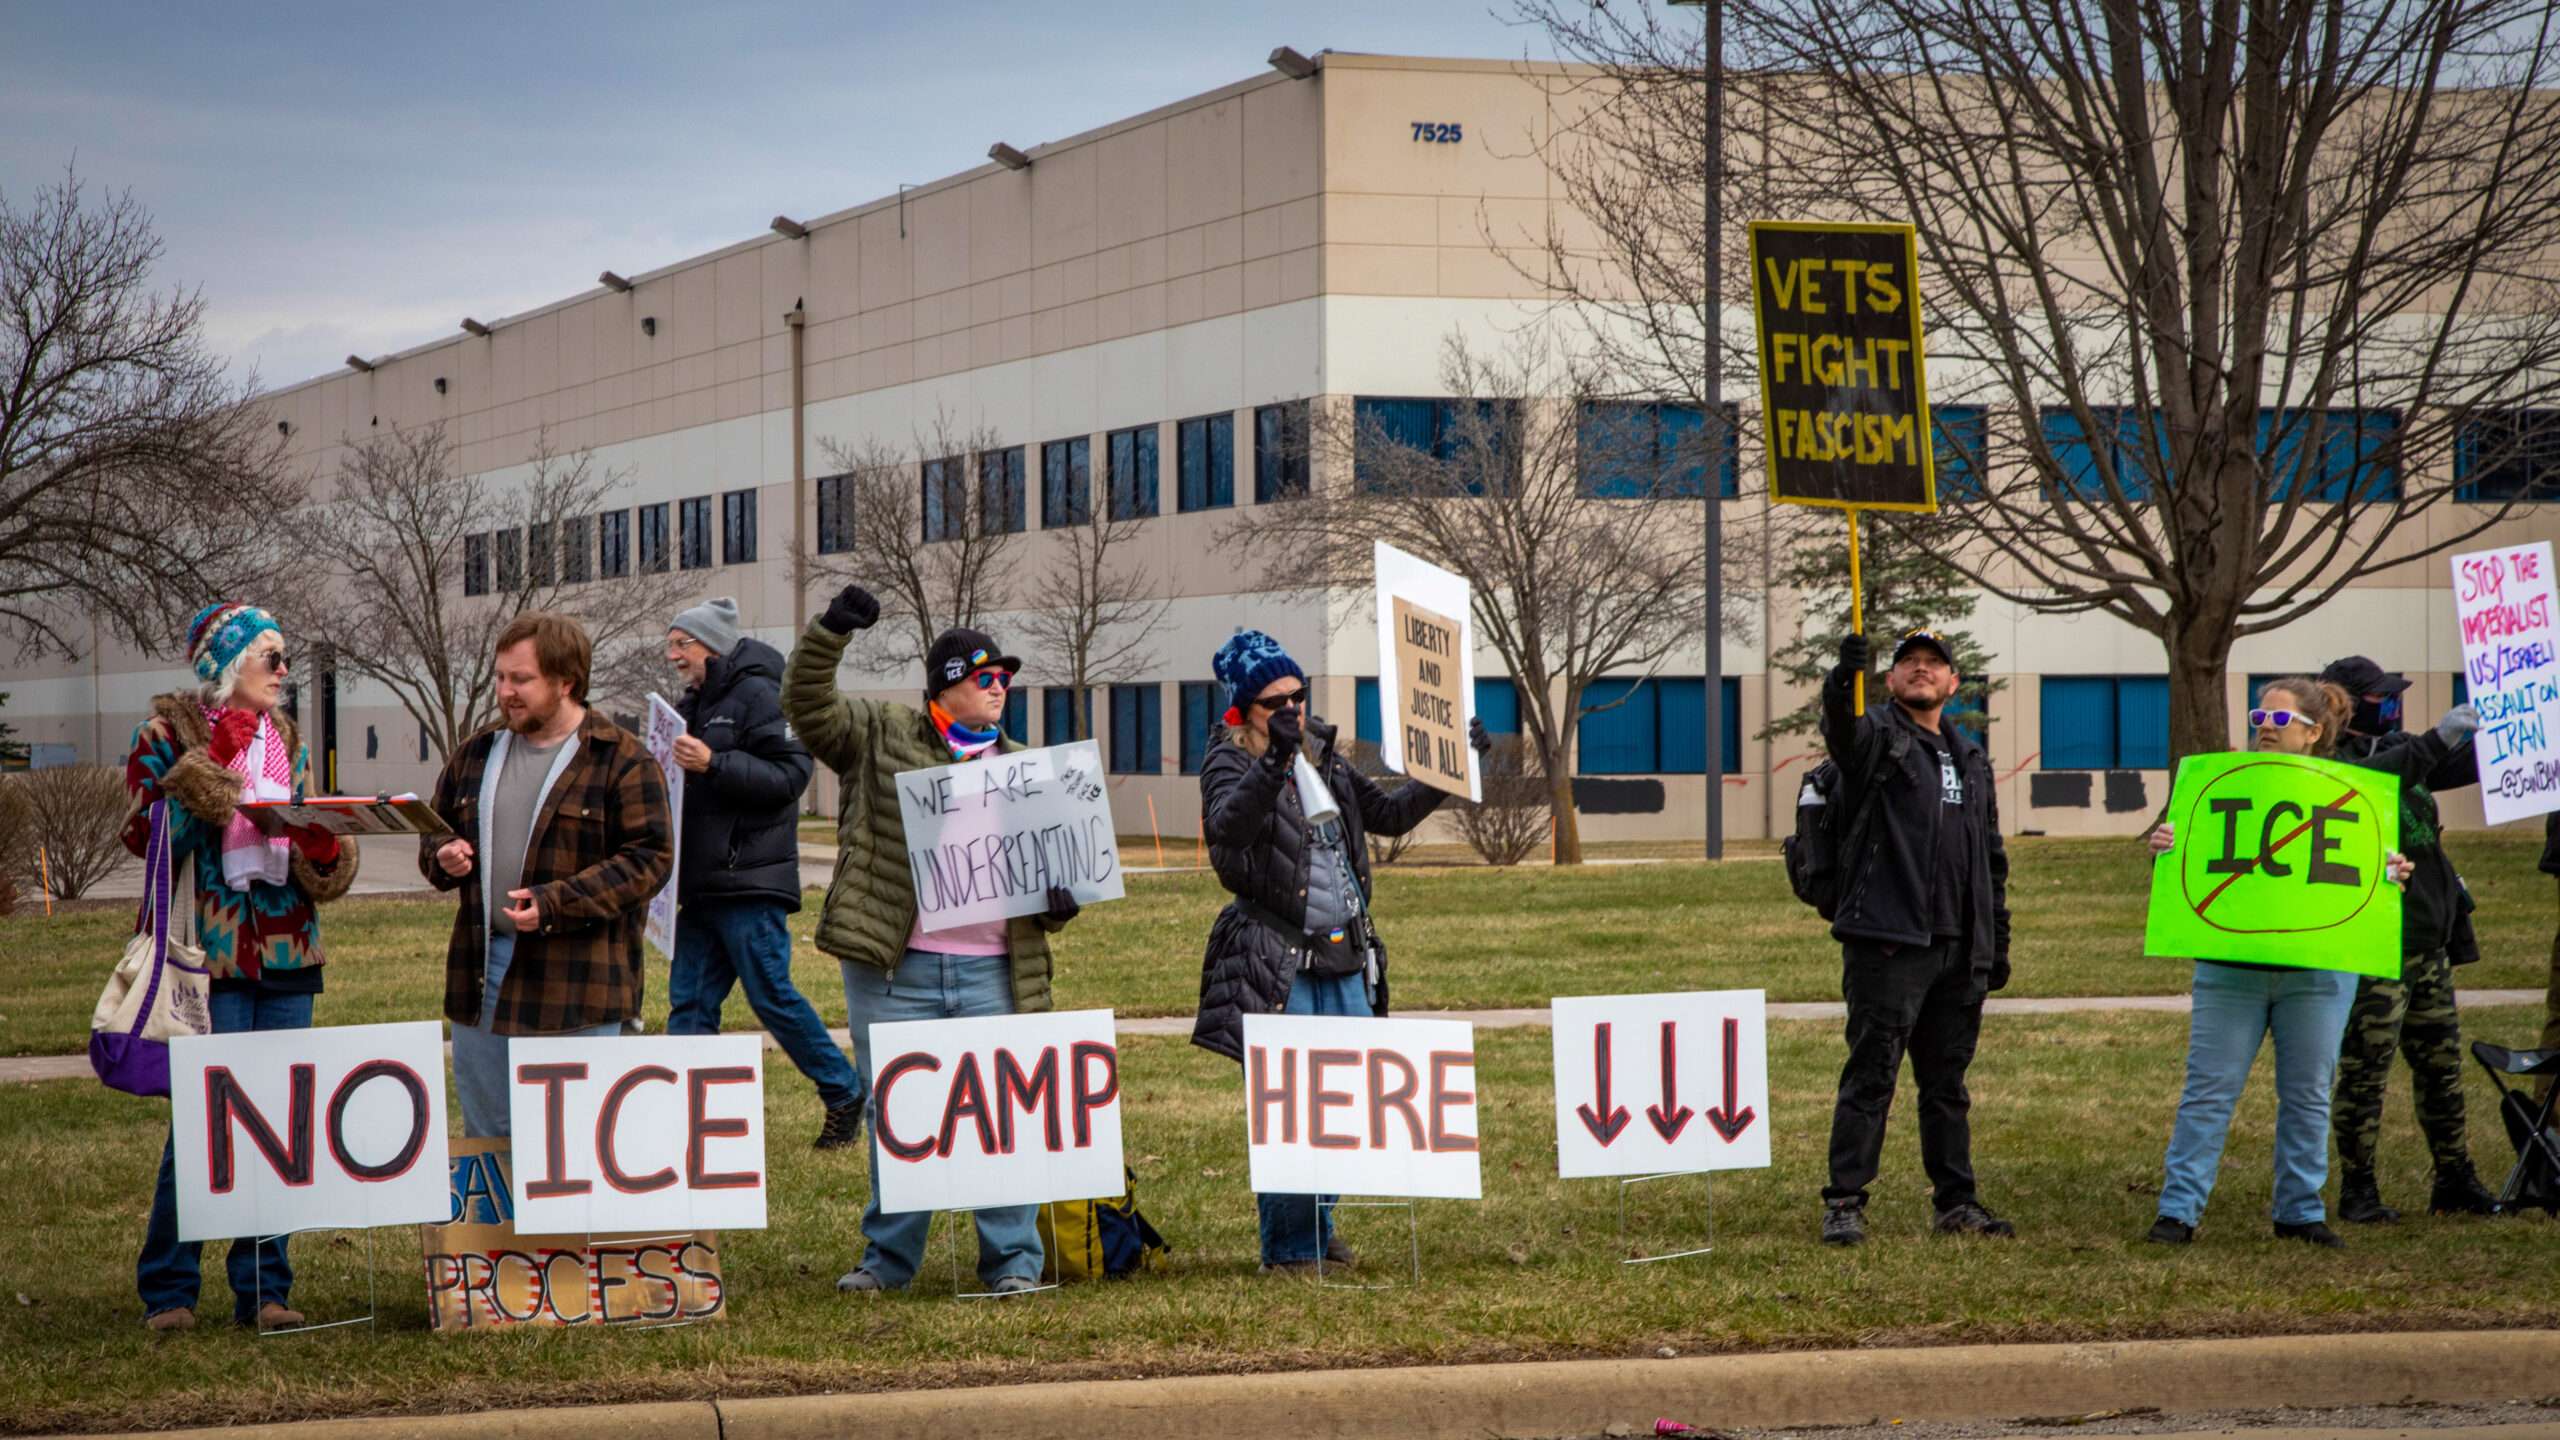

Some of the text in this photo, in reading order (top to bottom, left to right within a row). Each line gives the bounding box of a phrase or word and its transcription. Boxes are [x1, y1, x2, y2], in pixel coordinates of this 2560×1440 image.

[1411, 122, 1463, 143] 7525
[1765, 257, 1902, 314] VETS
[1773, 333, 1909, 390] FIGHT
[1777, 408, 1917, 466] FASCISM
[2462, 552, 2539, 602] STOP THE
[1404, 614, 1450, 658] LIBERTY
[2462, 593, 2548, 645] IMPERIALIST
[947, 667, 962, 680] ICE
[1419, 658, 1441, 687] AND
[1411, 688, 1453, 729] JUSTICE
[2474, 676, 2559, 727] ASSAULT ON
[1406, 725, 1465, 781] FOR ALL.
[2488, 712, 2546, 765] IRAN
[906, 761, 1042, 818] WE ARE
[1086, 784, 1102, 802] ICE
[911, 815, 1113, 913] UNDERREACTING
[2206, 797, 2361, 887] ICE
[204, 1060, 430, 1194] NO
[874, 1041, 1118, 1162] CAMP
[1250, 1046, 1479, 1152] HERE
[517, 1063, 760, 1199] ICE
[428, 1241, 724, 1330] PROCESS
